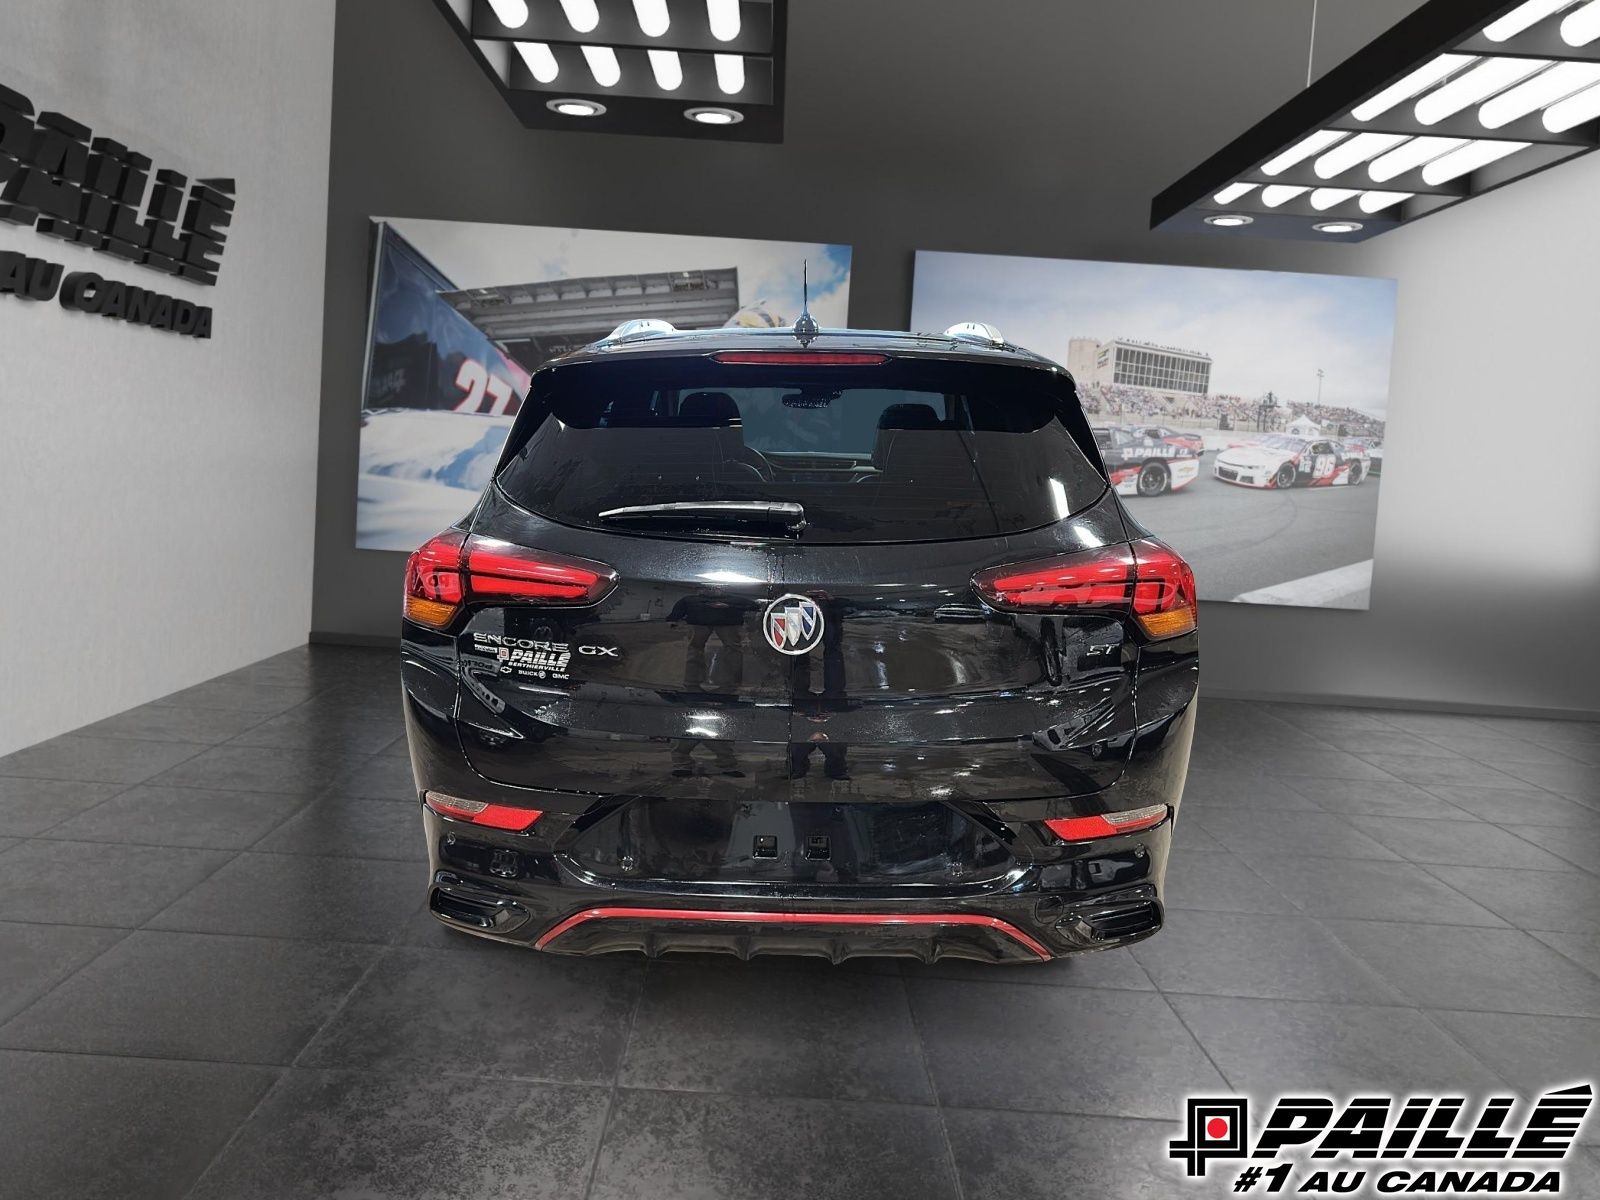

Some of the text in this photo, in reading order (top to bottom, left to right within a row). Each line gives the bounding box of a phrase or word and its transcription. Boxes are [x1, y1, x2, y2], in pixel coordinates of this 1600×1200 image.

[59, 271, 213, 339] CANADA
[453, 358, 513, 416] 27
[473, 632, 570, 653] ENCORE
[578, 644, 619, 657] GX
[1086, 643, 1120, 656] ST
[508, 661, 566, 673] BERTHIERVILLE
[518, 669, 539, 677] BUICK
